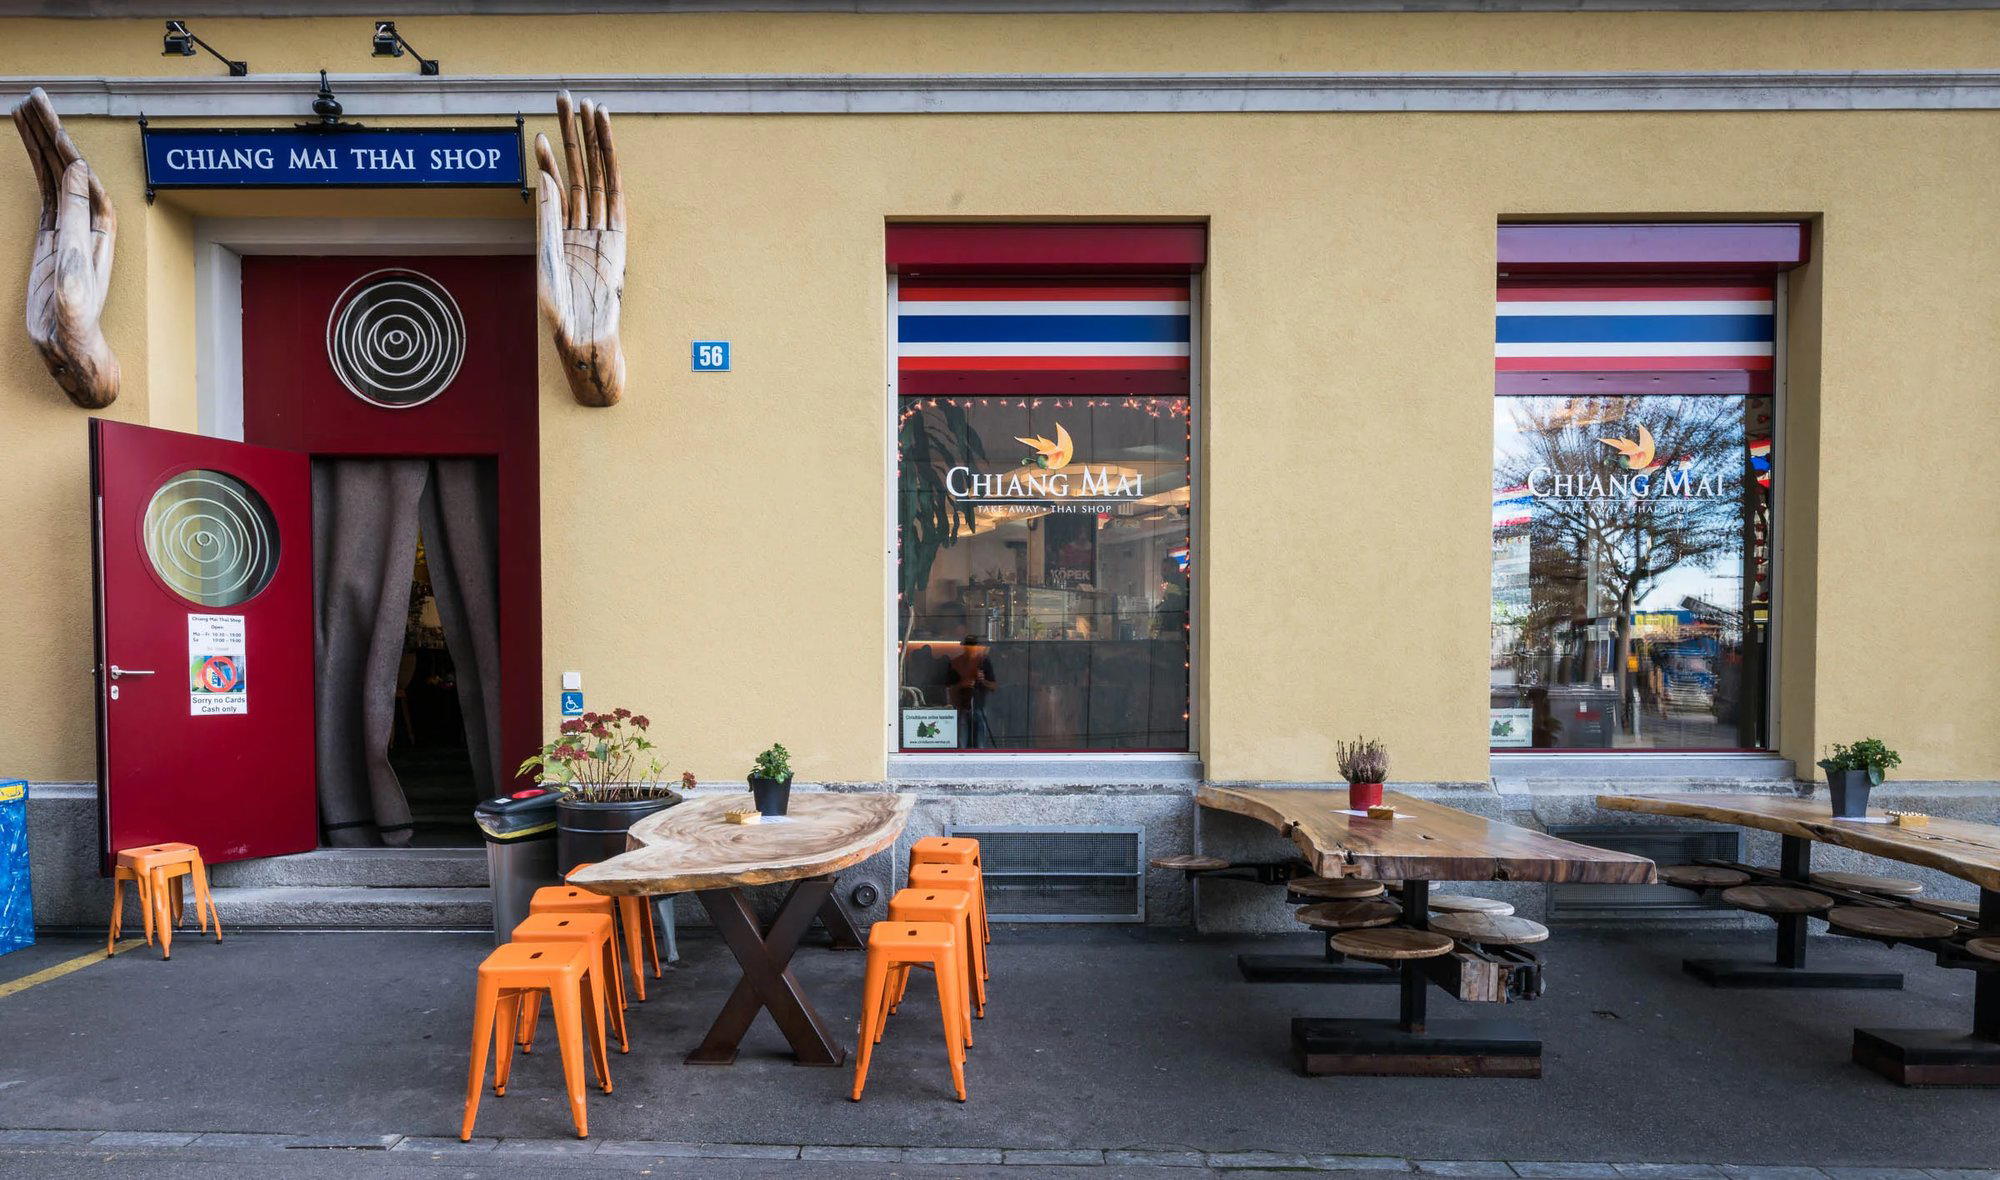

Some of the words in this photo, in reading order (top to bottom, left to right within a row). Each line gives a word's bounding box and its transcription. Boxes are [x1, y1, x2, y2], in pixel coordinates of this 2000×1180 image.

[166, 148, 274, 170] CHIANG
[289, 148, 338, 170] MAI
[351, 148, 416, 170] THAI
[430, 148, 501, 170] SHOP
[699, 345, 723, 367] 56
[946, 466, 1069, 497] CHIANG
[1081, 465, 1143, 497] MAI
[1527, 466, 1650, 498] CHIANG
[1662, 466, 1723, 497] MAI
[1051, 505, 1076, 514] THAI
[1082, 505, 1112, 514] SHOP
[192, 696, 212, 706] Sorry
[225, 696, 245, 704] Cards
[201, 705, 220, 713] Cash
[221, 705, 237, 714] only
